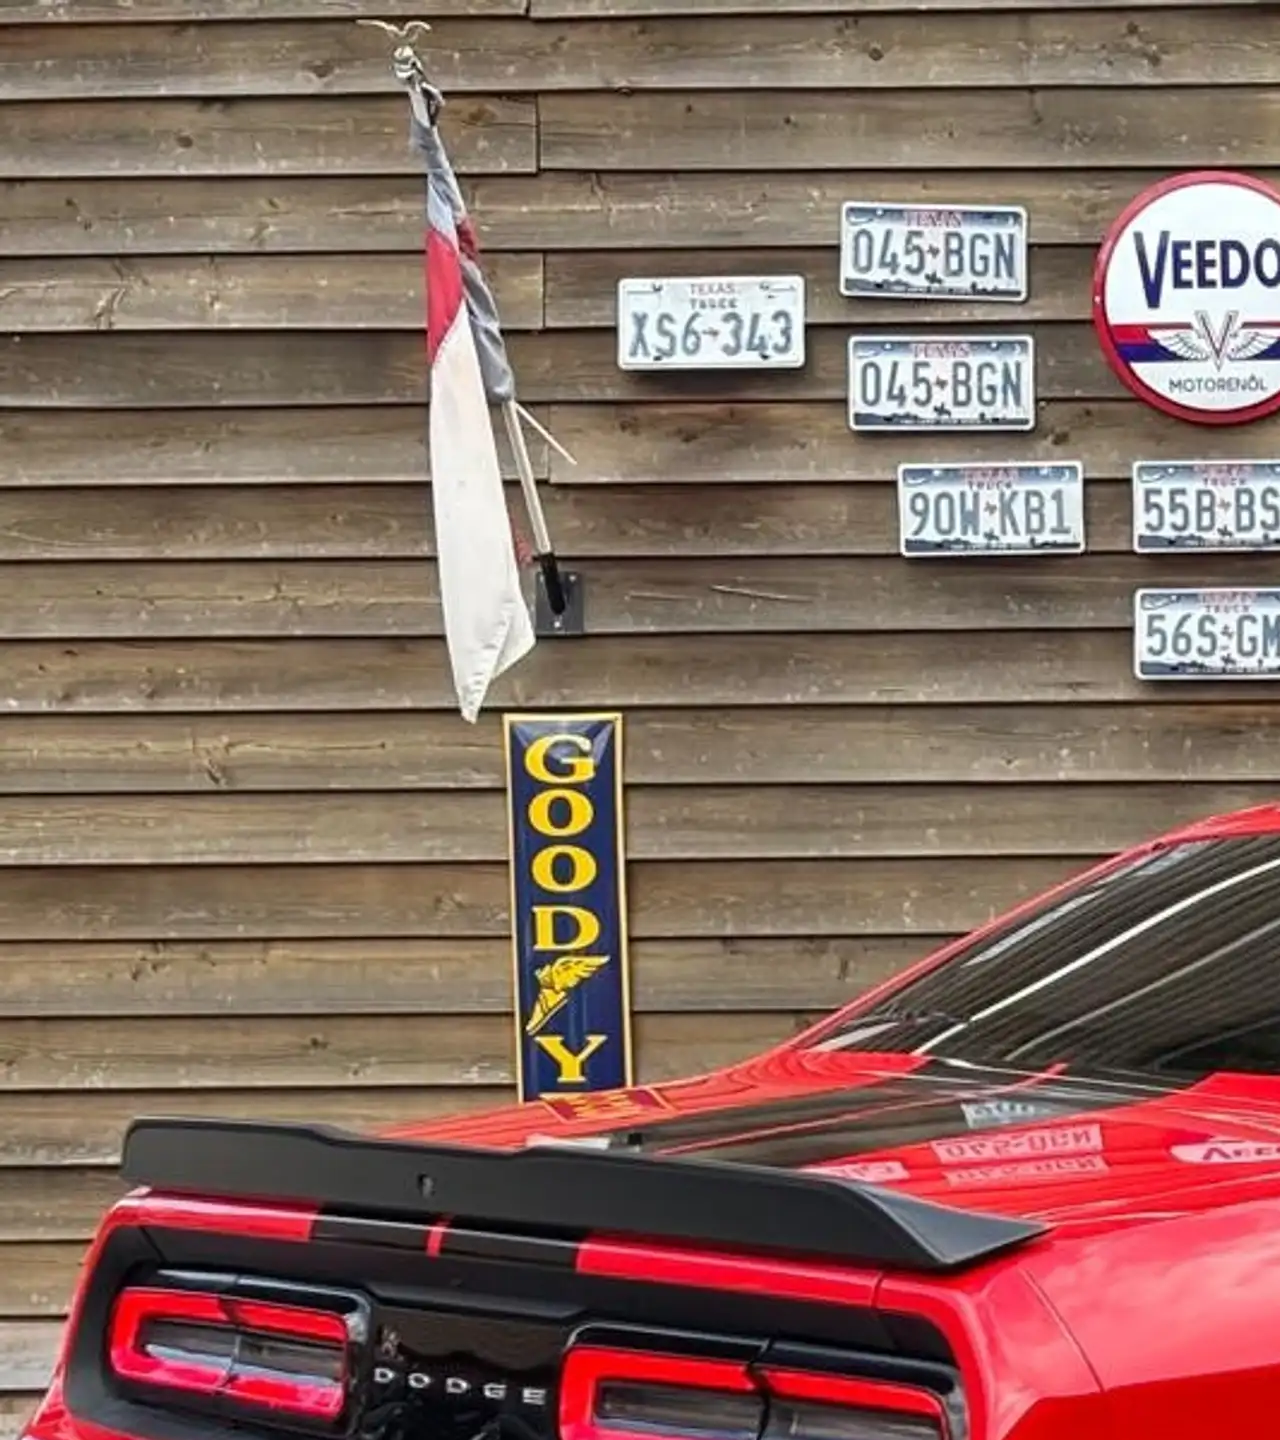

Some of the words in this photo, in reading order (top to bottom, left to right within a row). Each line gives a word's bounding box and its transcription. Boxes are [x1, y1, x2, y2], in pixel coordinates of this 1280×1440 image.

[852, 228, 926, 275] 045
[944, 231, 1015, 279] BGN
[690, 283, 736, 296] TEXAS
[628, 310, 702, 360] XS6
[722, 308, 792, 357] 343
[861, 360, 933, 407] 045
[952, 360, 1022, 408] BGN
[1143, 488, 1216, 533] 55B
[1146, 613, 1218, 658] 56S
[523, 733, 609, 1100] GOODY
[374, 1367, 547, 1405] DODGE
